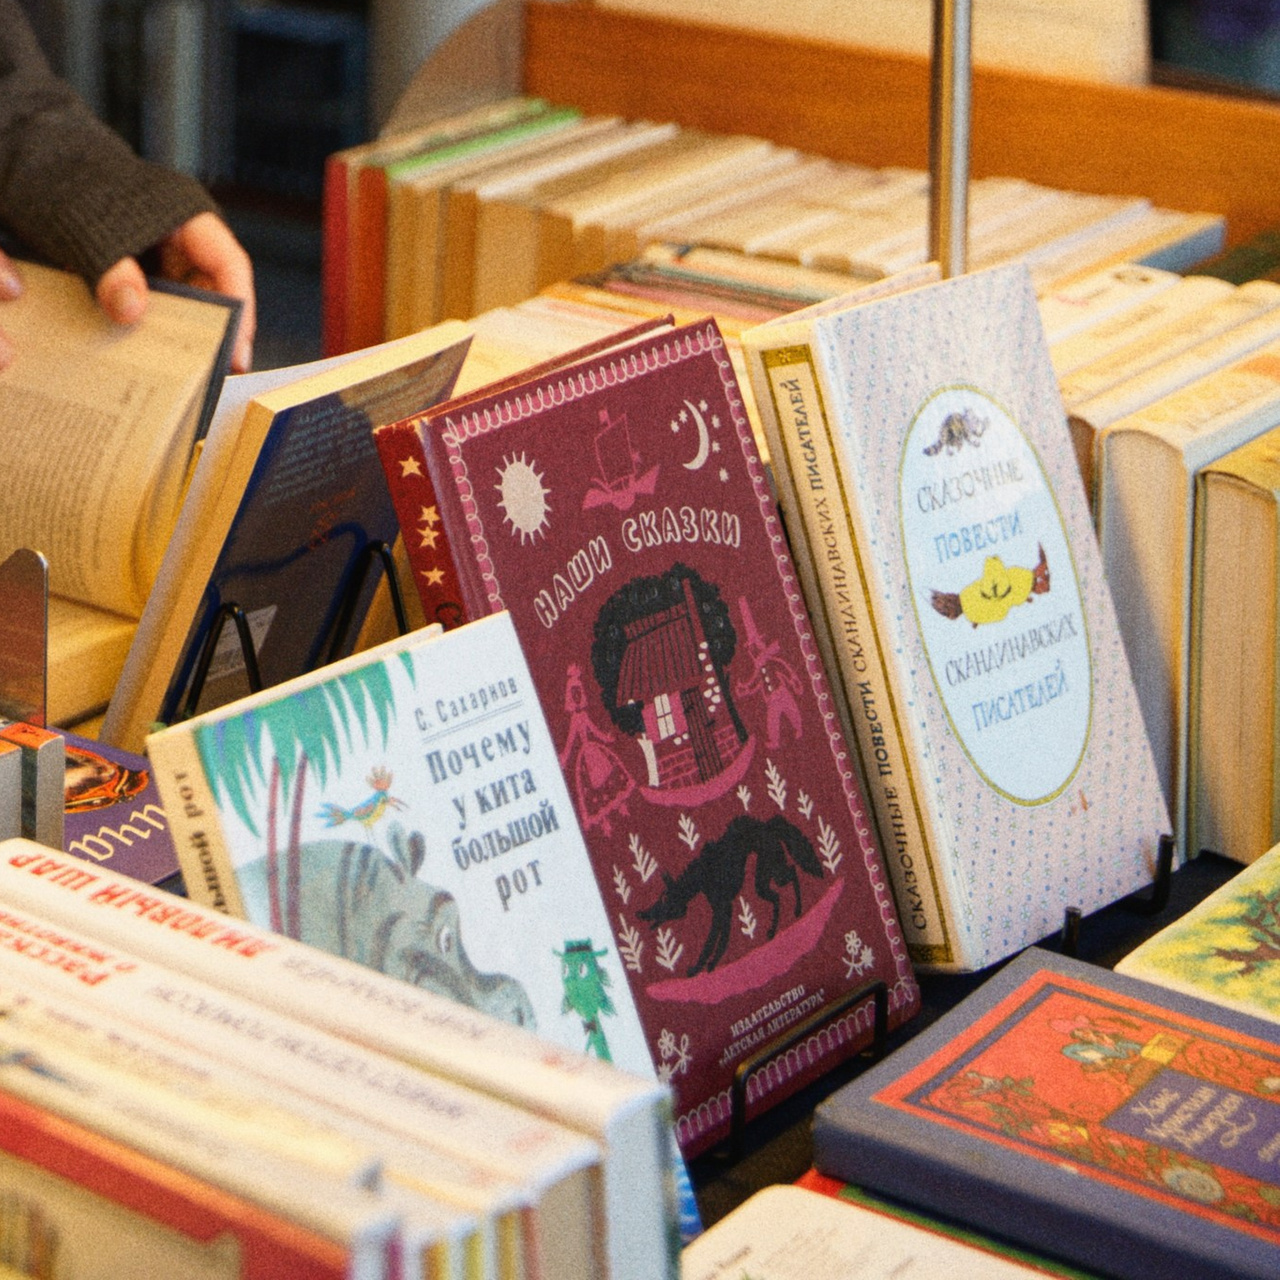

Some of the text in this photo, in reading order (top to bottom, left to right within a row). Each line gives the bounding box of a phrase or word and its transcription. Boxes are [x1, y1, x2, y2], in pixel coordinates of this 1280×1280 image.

[917, 458, 1023, 514] СКАЗОЧНЫЕ
[533, 506, 741, 629] НАШИ СКАЗКИ
[934, 509, 1024, 564] ПОВЕСТИ
[779, 377, 927, 931] СКАЗОЧНЫЕ ПОВЕСТИ СКАНДИНАВСКИХ ПИСАТЕЛЕЙ
[945, 613, 1078, 687] СКАНДИНАВСКИХ
[414, 676, 518, 732] С. Сахарнов
[972, 658, 1070, 733] ПИСАТЕЛЕЙ
[425, 719, 532, 785] Почему
[452, 768, 537, 831] у кита
[174, 770, 230, 915] ьшой рот
[451, 799, 560, 871] большой
[8, 851, 279, 959] ЛИЛОВЫЙ ШАР
[495, 859, 543, 913] рот
[730, 984, 805, 1038] ИЗДАТЕЛЬСТВО
